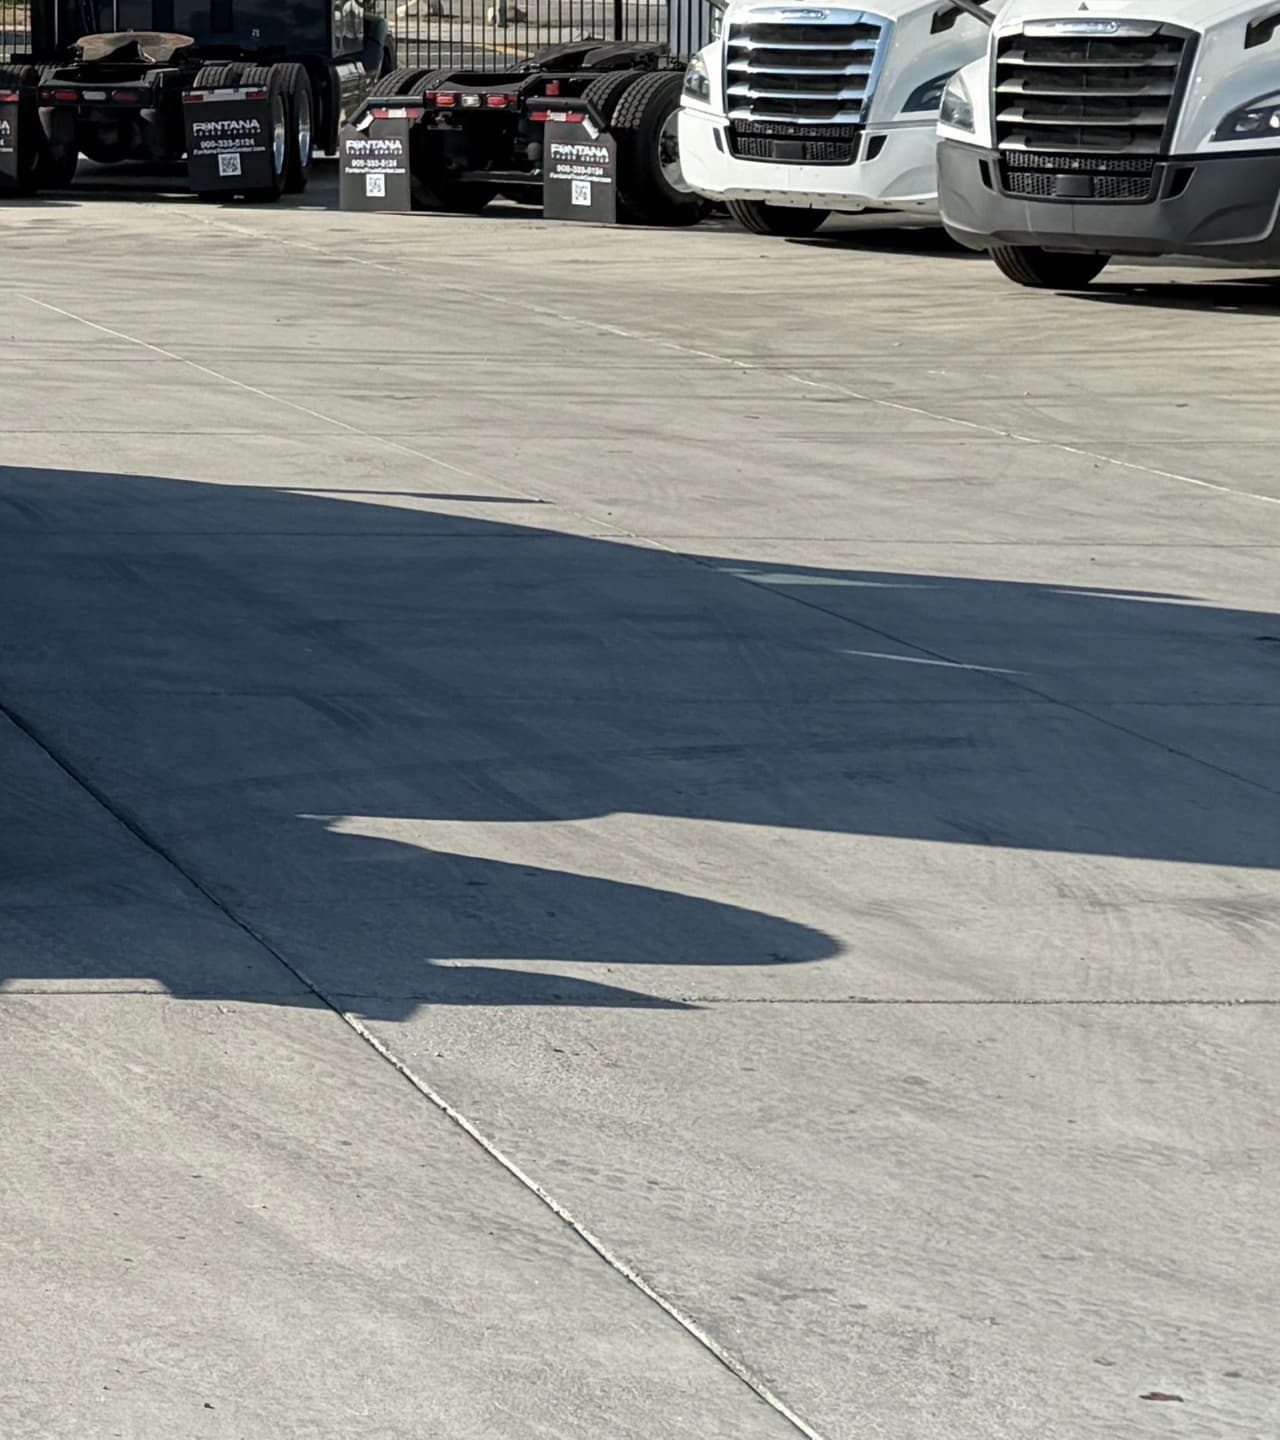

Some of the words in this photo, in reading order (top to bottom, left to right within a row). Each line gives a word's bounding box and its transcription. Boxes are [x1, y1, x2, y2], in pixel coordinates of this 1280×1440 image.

[193, 119, 261, 131] FONTANA
[345, 140, 402, 150] FONTANA
[550, 143, 609, 156] FONTANA
